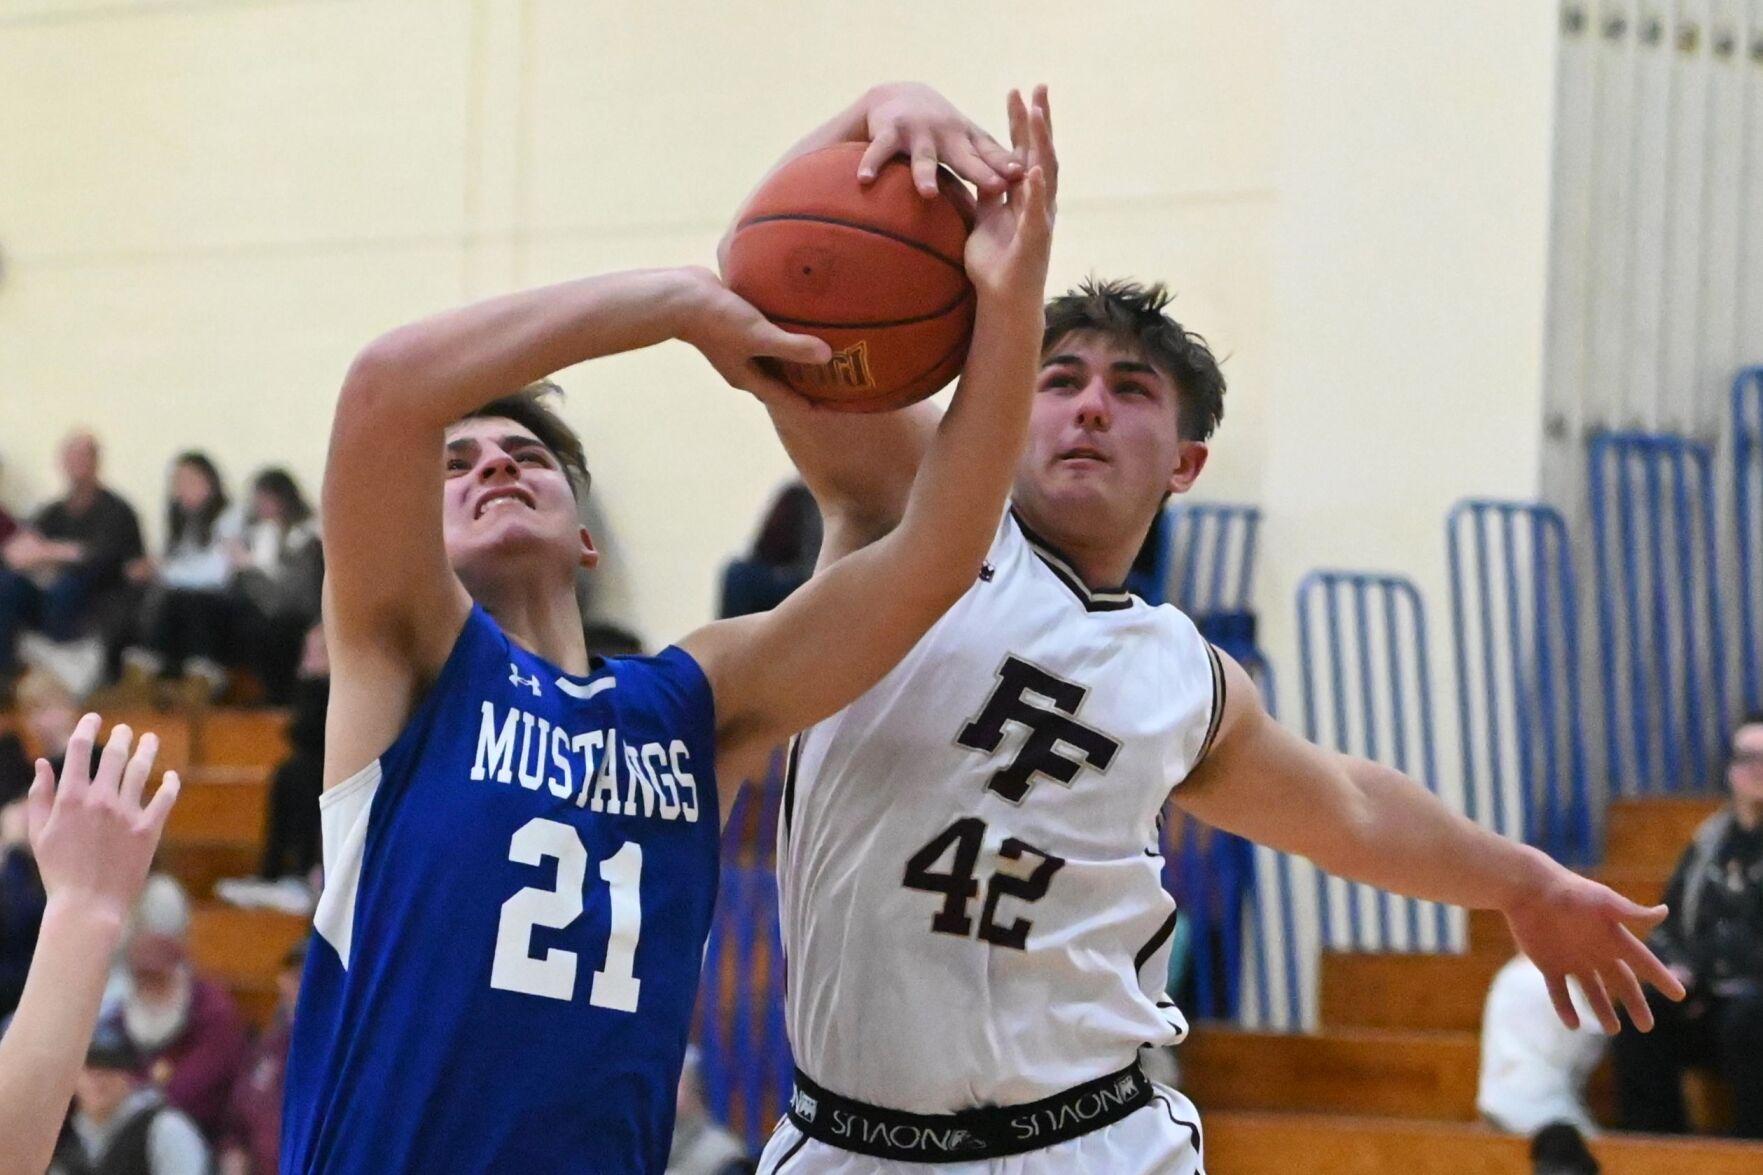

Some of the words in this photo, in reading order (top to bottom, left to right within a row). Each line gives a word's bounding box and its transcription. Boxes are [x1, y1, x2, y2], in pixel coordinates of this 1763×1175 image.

[470, 700, 699, 822] MUSTANGS
[490, 817, 643, 1013] 21
[903, 817, 1066, 951] 42
[831, 1110, 951, 1151] NOVUS
[1011, 1081, 1123, 1139] NOVUS
